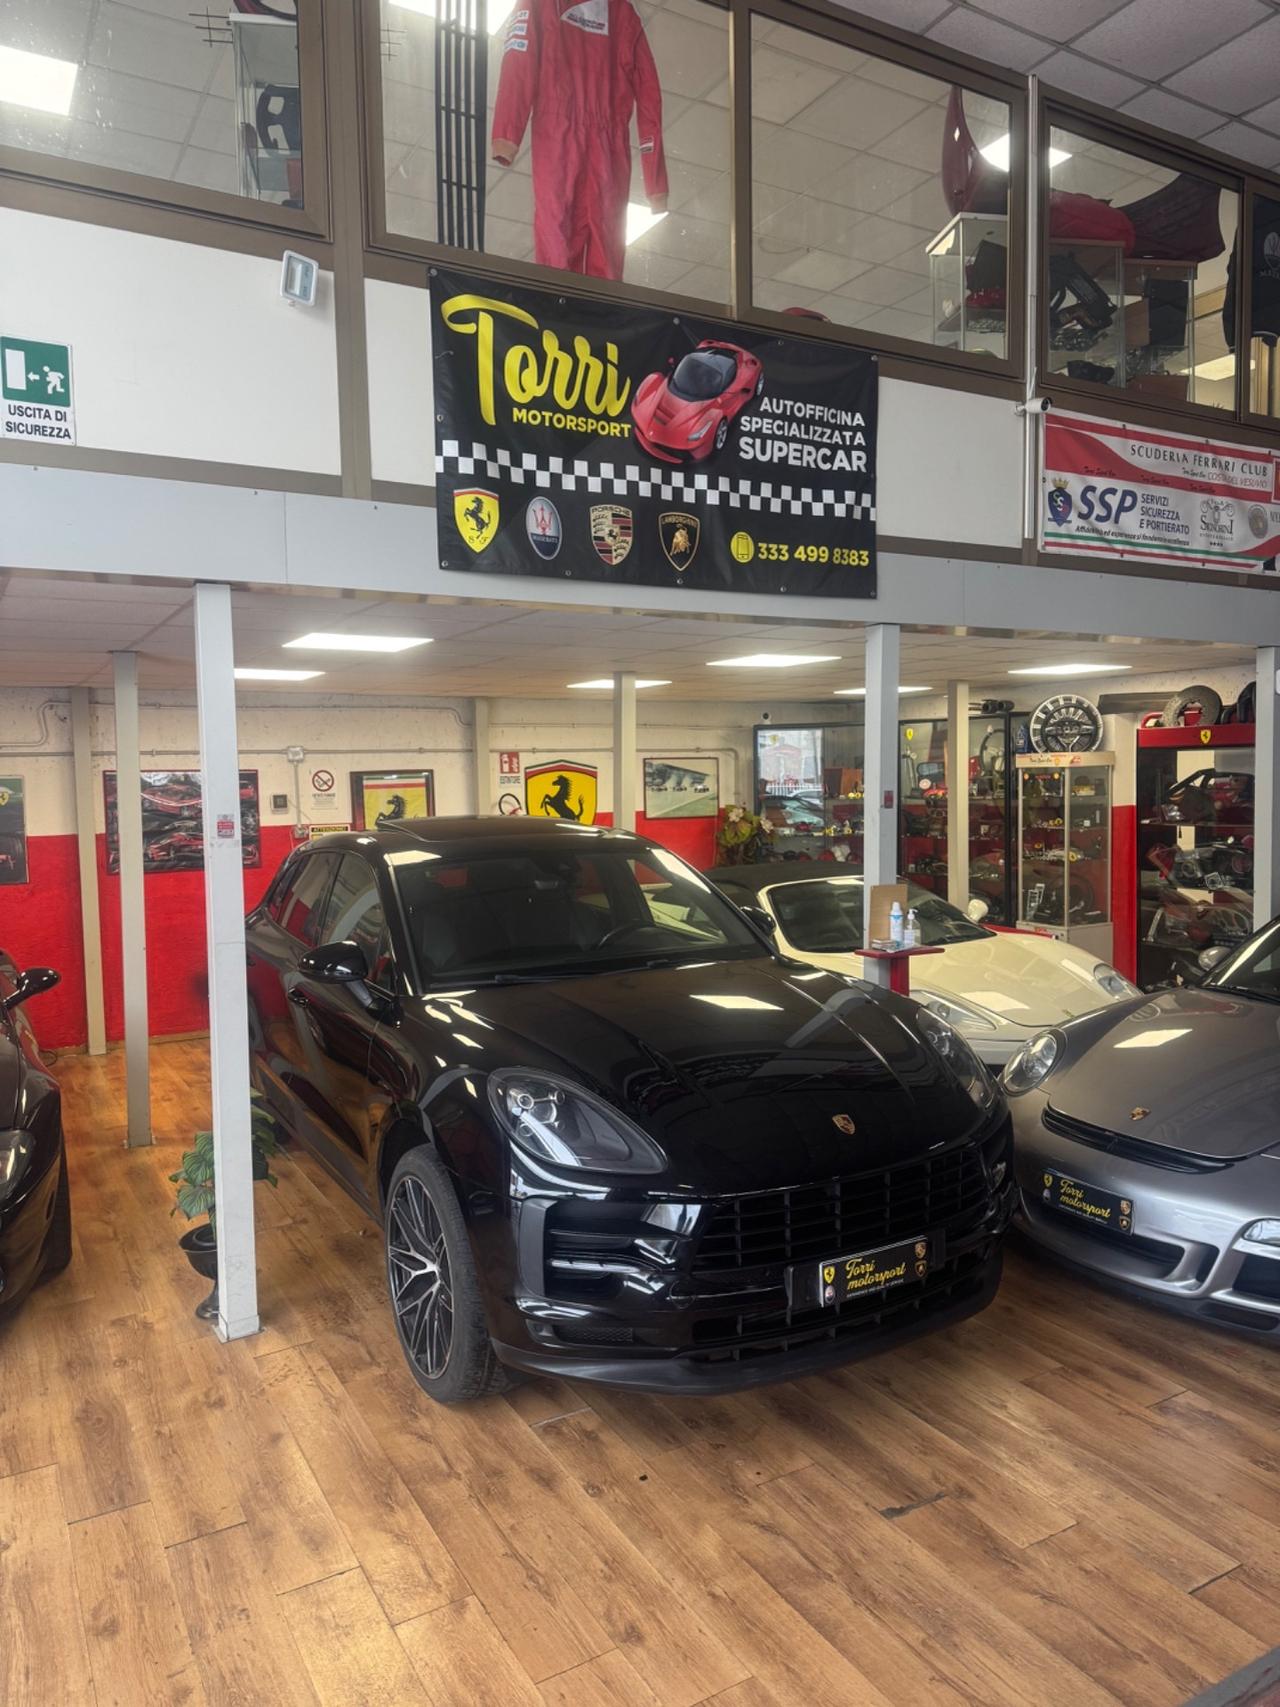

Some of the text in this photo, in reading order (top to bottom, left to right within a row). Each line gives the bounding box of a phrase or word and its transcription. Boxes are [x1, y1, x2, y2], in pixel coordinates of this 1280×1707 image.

[441, 294, 631, 425] Torri
[8, 404, 67, 422] USCITA DI
[512, 407, 631, 438] MOTORSPORT
[760, 397, 865, 427] AUTOFFICINA
[5, 420, 72, 440] SICUREZZA
[740, 415, 867, 447] SPECIALIZZATA
[739, 436, 867, 473] SUPERCAR
[1130, 444, 1189, 463] SCUDERIA
[1193, 454, 1236, 472] FERRARI
[1241, 463, 1268, 477] CLUB
[592, 505, 631, 517] PORSCHE
[1077, 485, 1138, 525] SSP
[1141, 493, 1169, 506] SERVIZI
[1140, 506, 1180, 521] SICUREZZA
[1139, 519, 1190, 535] E PORTIERATO
[757, 542, 869, 567] 333 499 8383
[1060, 1179, 1084, 1198] Torri
[1060, 1195, 1111, 1218] motorsport
[846, 1258, 875, 1279] Torri
[847, 1262, 906, 1290] motorsport
